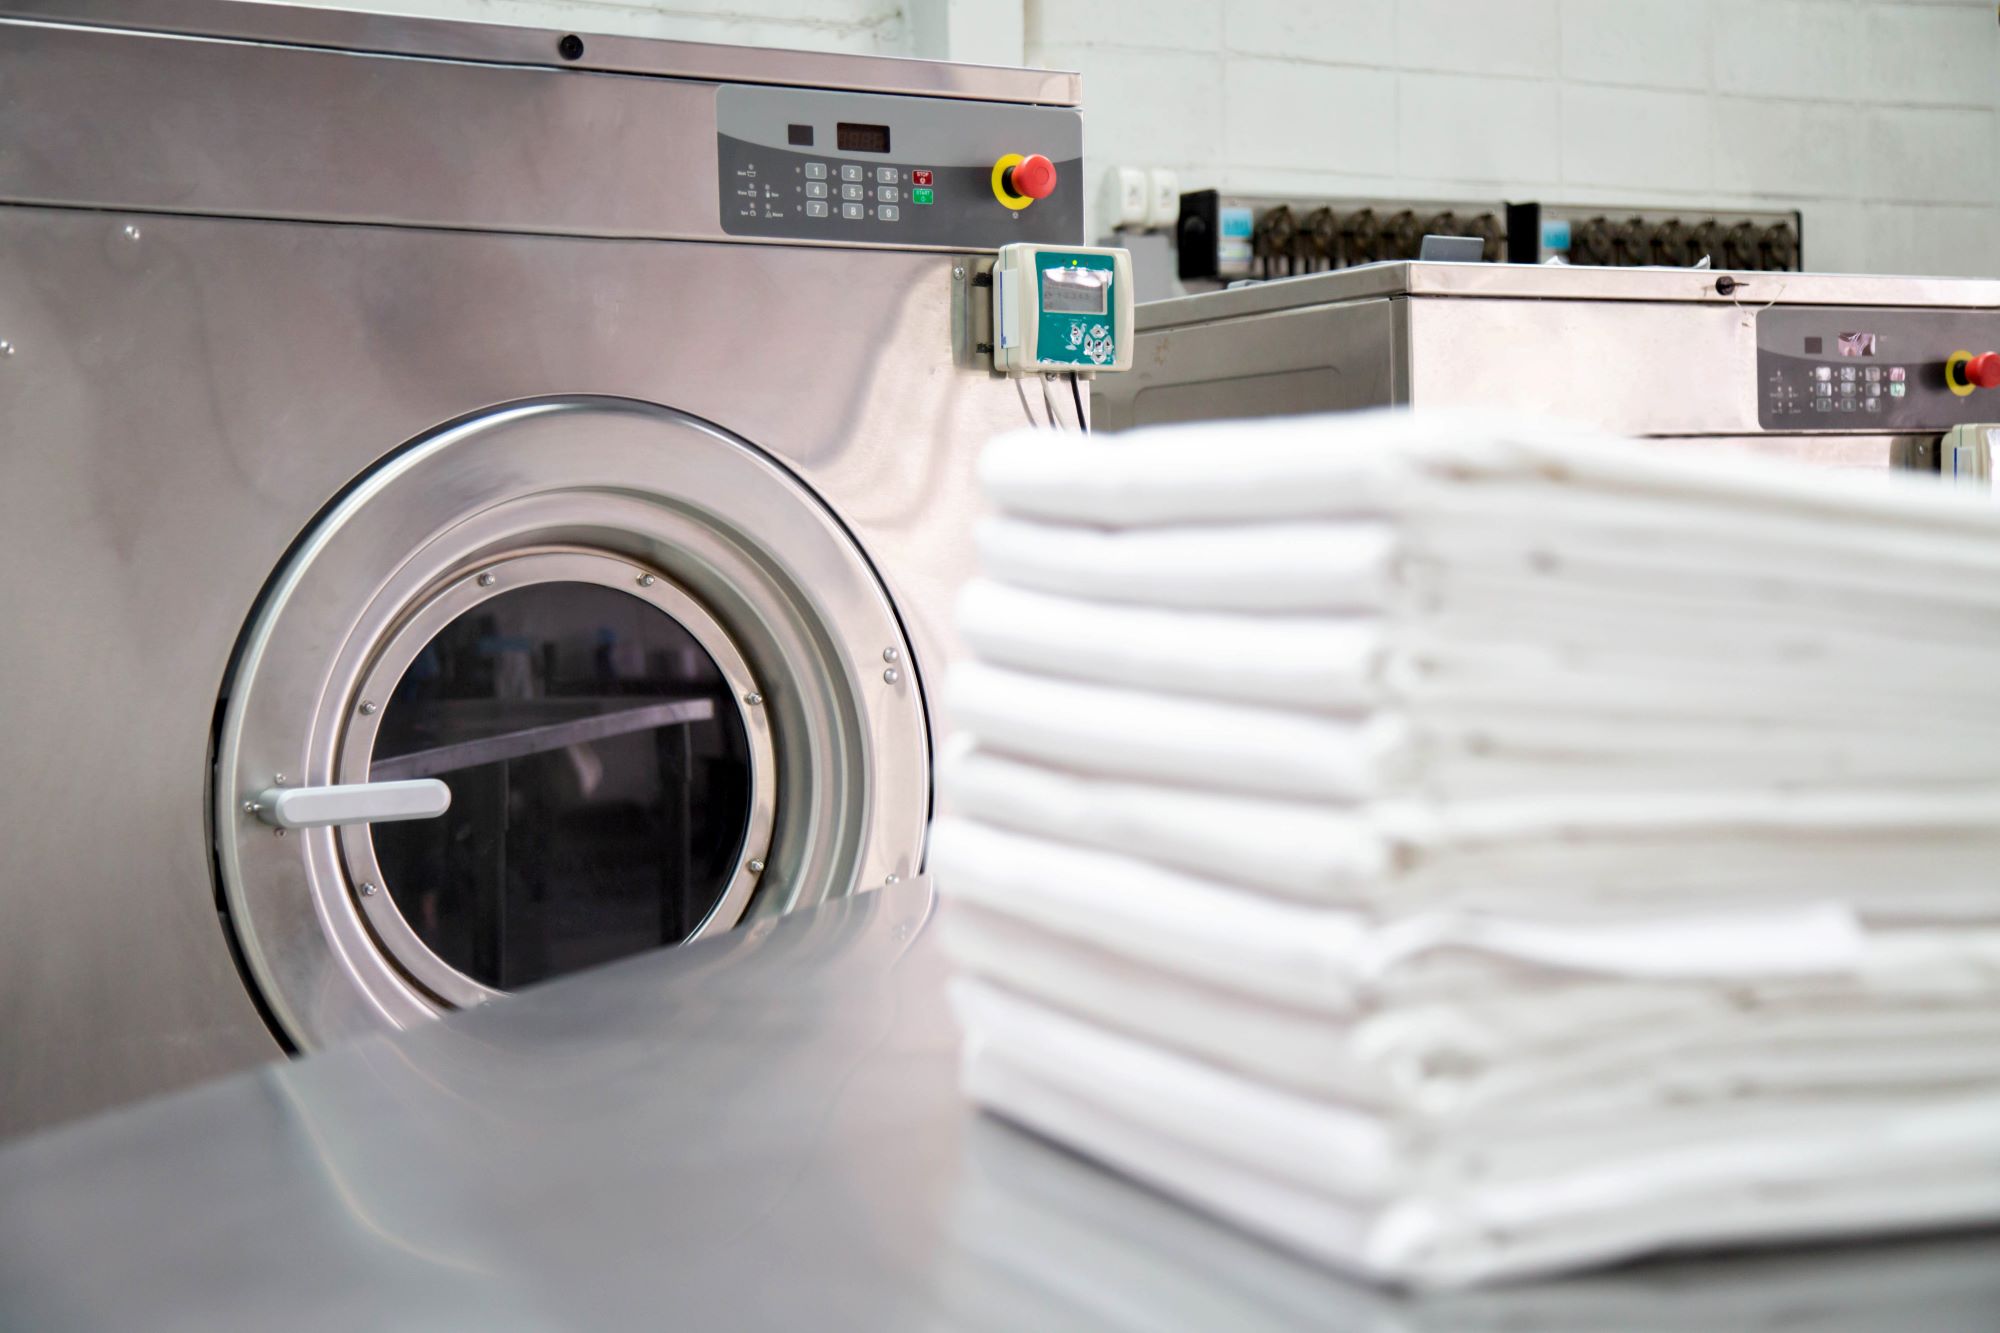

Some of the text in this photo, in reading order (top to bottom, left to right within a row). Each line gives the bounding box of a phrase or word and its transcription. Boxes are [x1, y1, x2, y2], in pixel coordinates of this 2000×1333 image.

[814, 167, 819, 176] 1
[849, 169, 855, 178] 2
[884, 171, 891, 180] 3
[814, 186, 820, 195] 4
[849, 188, 856, 197] 5
[885, 190, 892, 199] 6
[814, 205, 821, 214] 7
[850, 207, 857, 216] 8
[886, 208, 892, 218] 9
